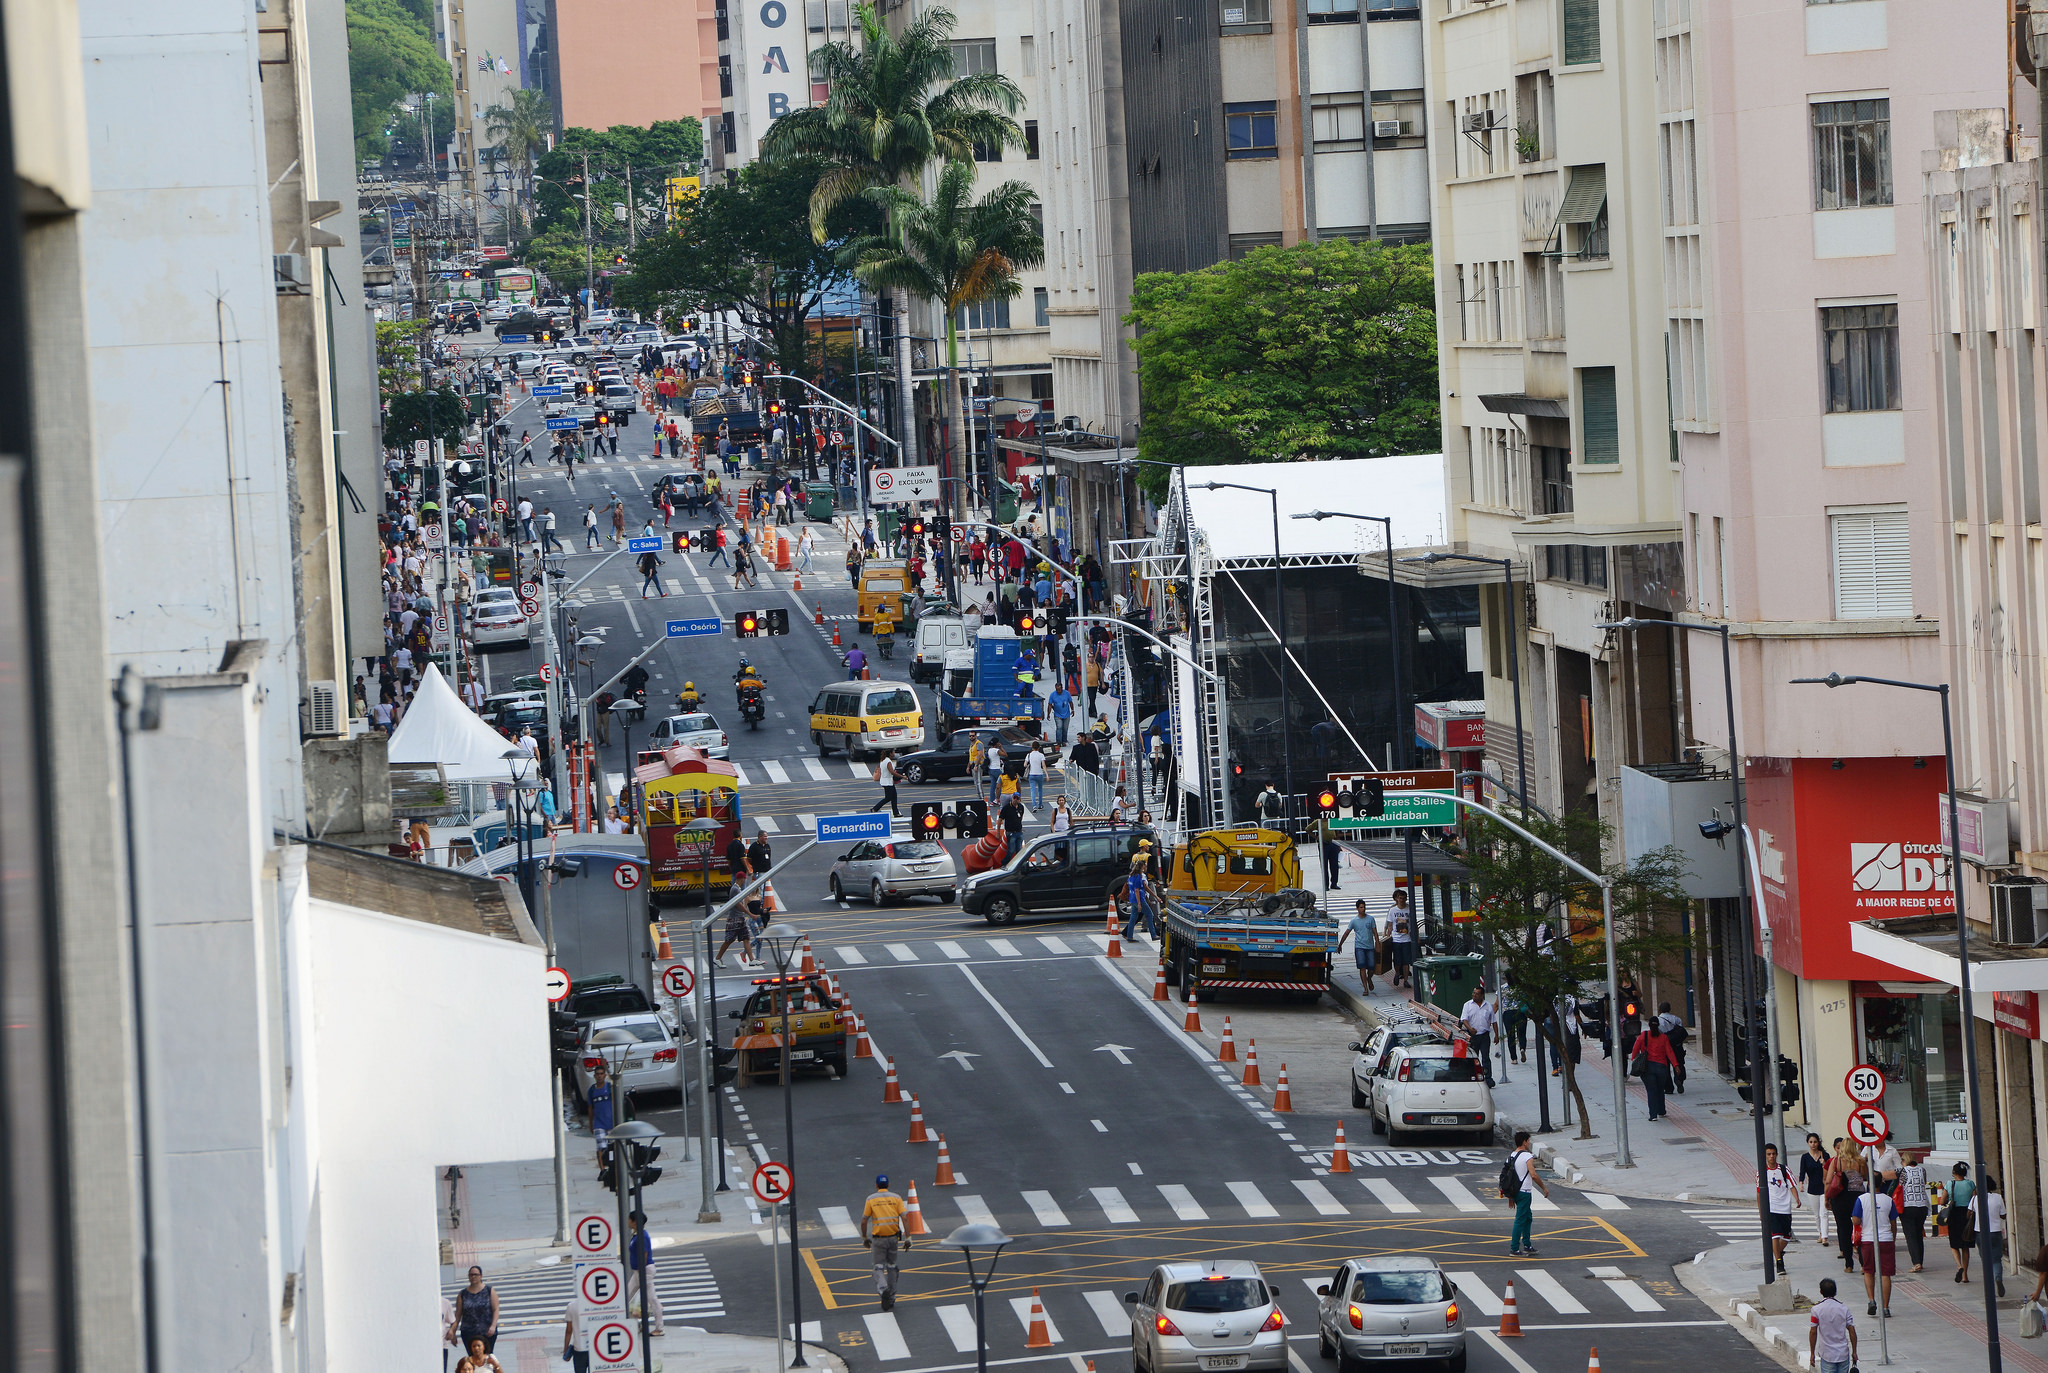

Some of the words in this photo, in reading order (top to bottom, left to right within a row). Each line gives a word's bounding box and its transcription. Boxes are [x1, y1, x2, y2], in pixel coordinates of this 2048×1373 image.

[760, 0, 790, 120] OAB
[898, 478, 934, 486] EXCLUSIVA
[431, 527, 436, 536] E
[524, 585, 534, 593] 50
[440, 619, 445, 628] E
[690, 623, 717, 631] Osório
[876, 716, 910, 725] ESCOLAR
[1384, 798, 1410, 807] oraes
[1413, 796, 1446, 806] Salles
[1370, 810, 1428, 822] Aquidaban
[822, 821, 884, 834] Bernardino
[962, 830, 970, 838] C
[924, 831, 940, 840] 170
[1904, 841, 1942, 854] ÓTICAS
[622, 868, 631, 884] E
[1856, 898, 1863, 906] A
[1866, 898, 1897, 907] MAIOR
[1900, 898, 1926, 907] REDE
[1928, 898, 1941, 907] DE
[672, 972, 683, 990] E
[1820, 999, 1846, 1014] 1275
[1854, 1073, 1878, 1091] 50
[1860, 1114, 1876, 1138] E
[766, 1171, 780, 1193] E
[588, 1224, 601, 1244] E
[595, 1275, 608, 1297] E
[607, 1332, 622, 1354] E
